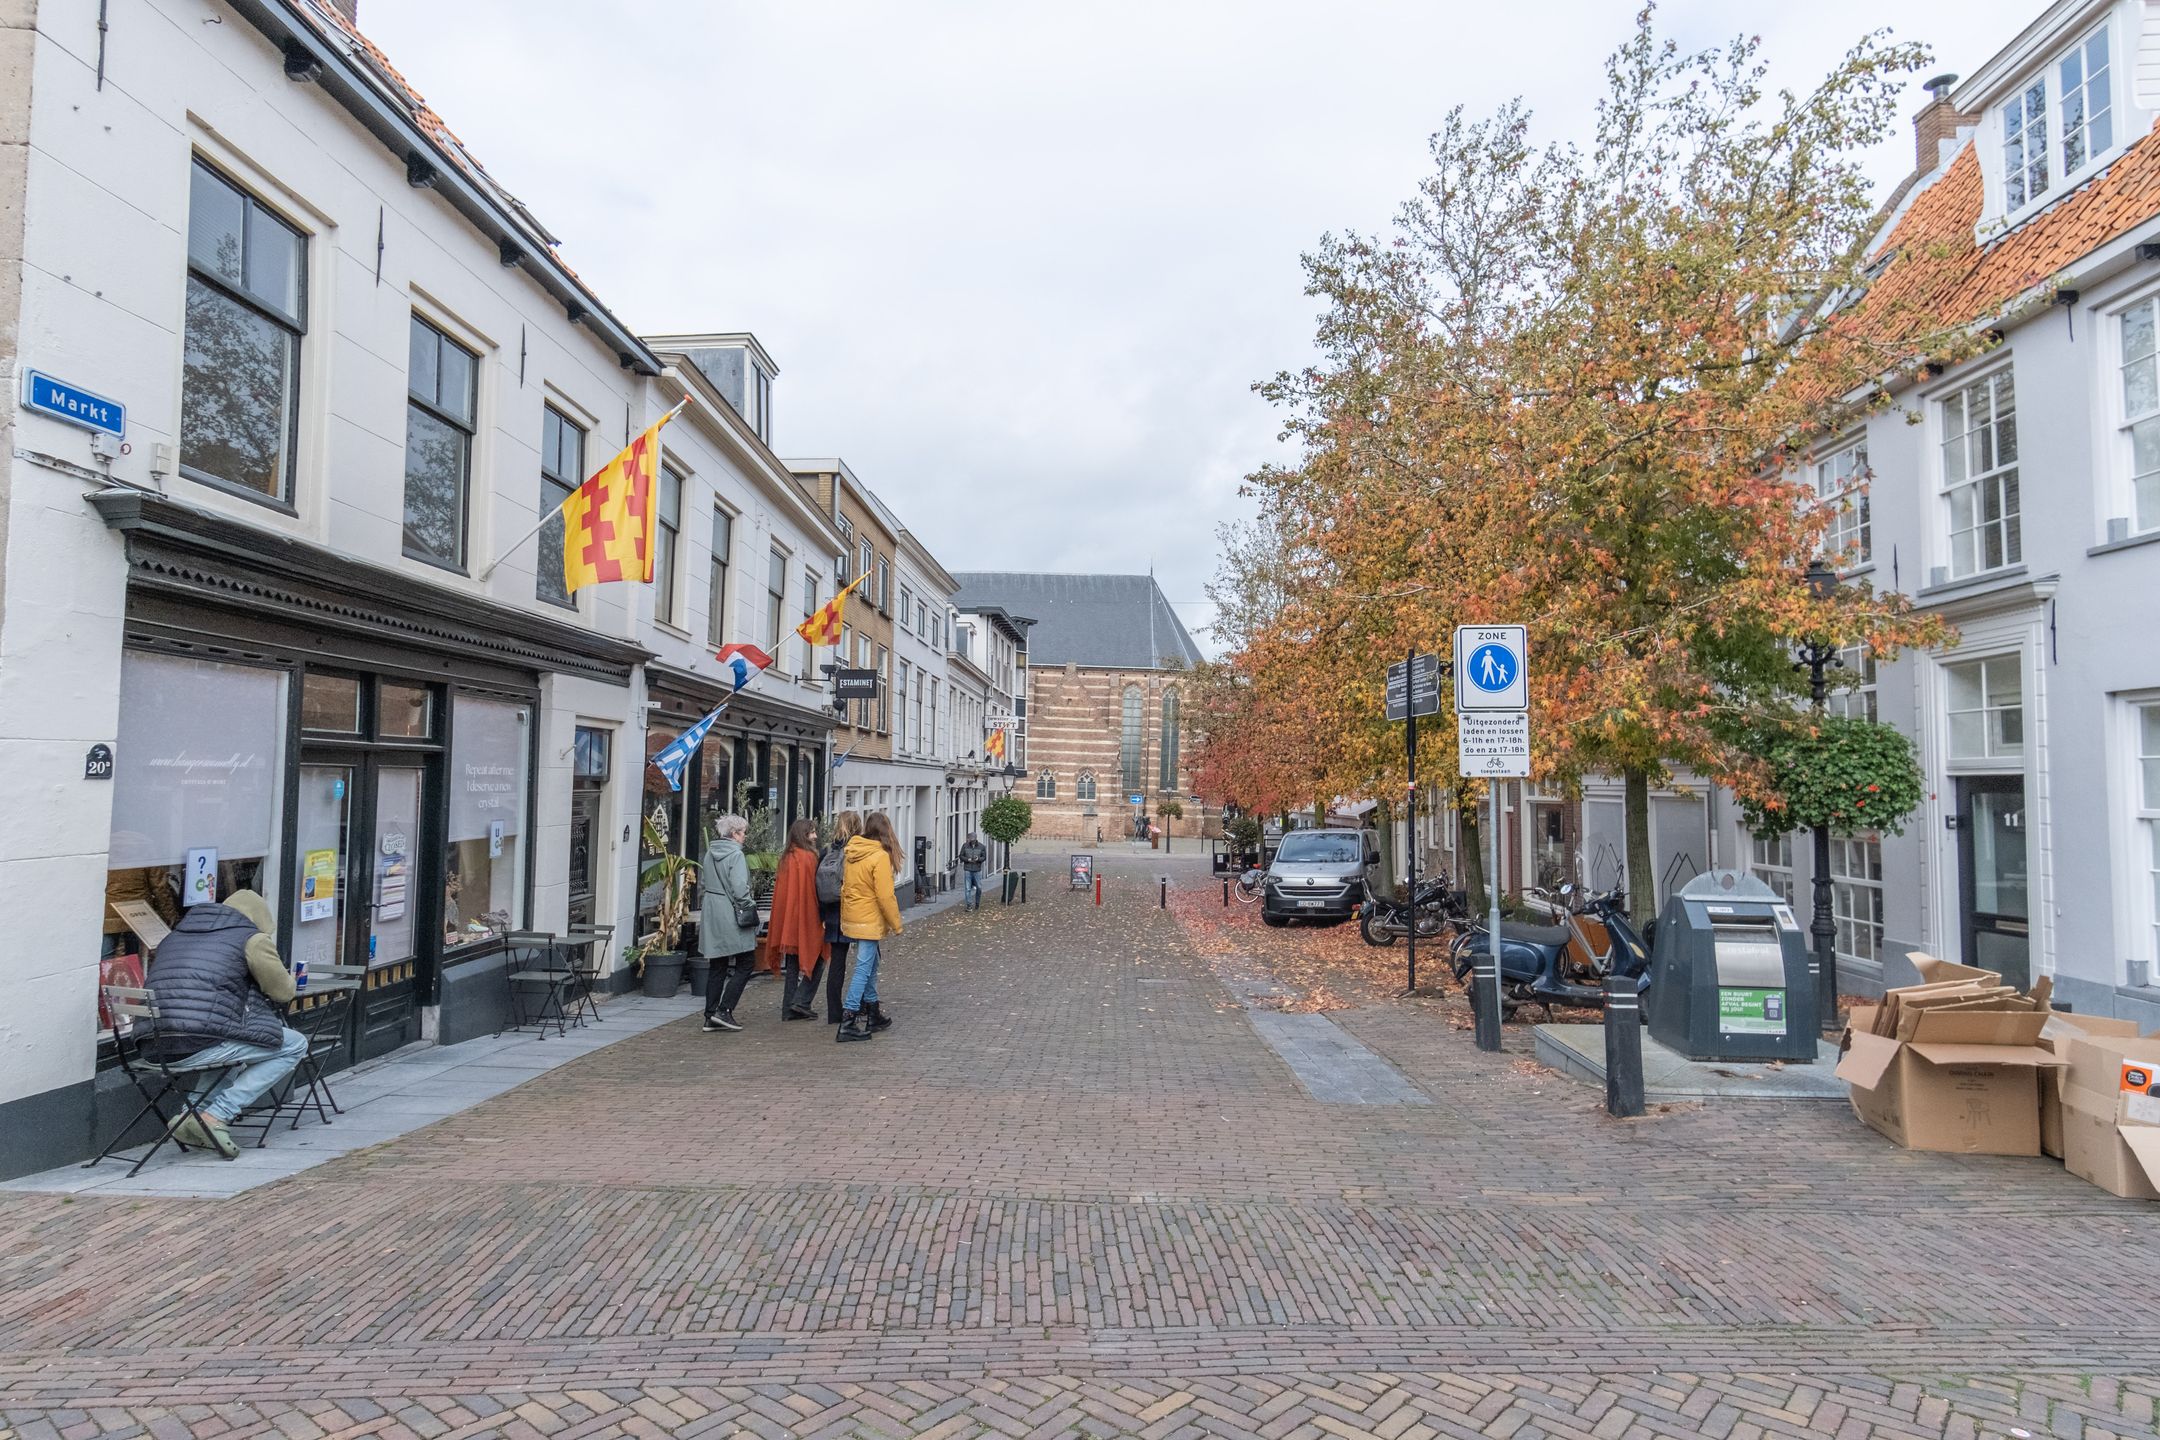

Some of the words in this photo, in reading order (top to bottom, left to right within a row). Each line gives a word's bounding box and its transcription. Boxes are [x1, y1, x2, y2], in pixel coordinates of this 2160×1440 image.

[51, 388, 108, 423] Markt
[1478, 632, 1507, 640] ZONE
[839, 679, 873, 689] ESTAMINET
[1467, 718, 1520, 726] Uitgezonderd
[465, 763, 487, 778] Repeat
[488, 764, 502, 775] after
[502, 766, 515, 776] me
[470, 780, 494, 792] deserve
[499, 784, 512, 792] new
[478, 798, 500, 811] crystal
[2004, 813, 2018, 827] 11
